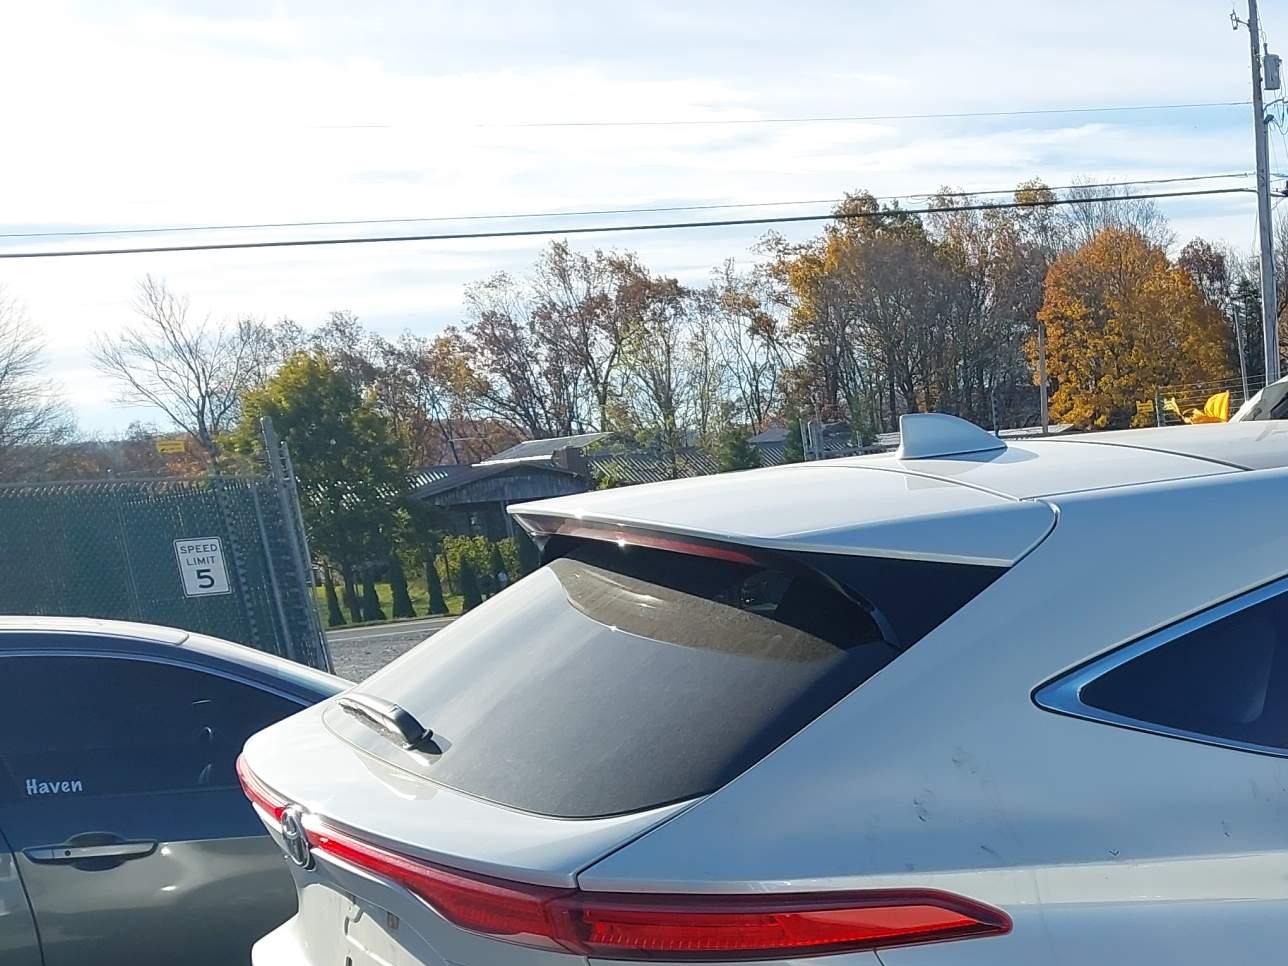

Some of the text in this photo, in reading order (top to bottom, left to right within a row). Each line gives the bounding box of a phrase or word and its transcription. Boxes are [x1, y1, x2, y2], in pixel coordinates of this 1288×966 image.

[180, 543, 218, 554] SPEED
[186, 556, 216, 566] LIMIT
[196, 568, 215, 589] 5
[26, 778, 83, 796] Haven
